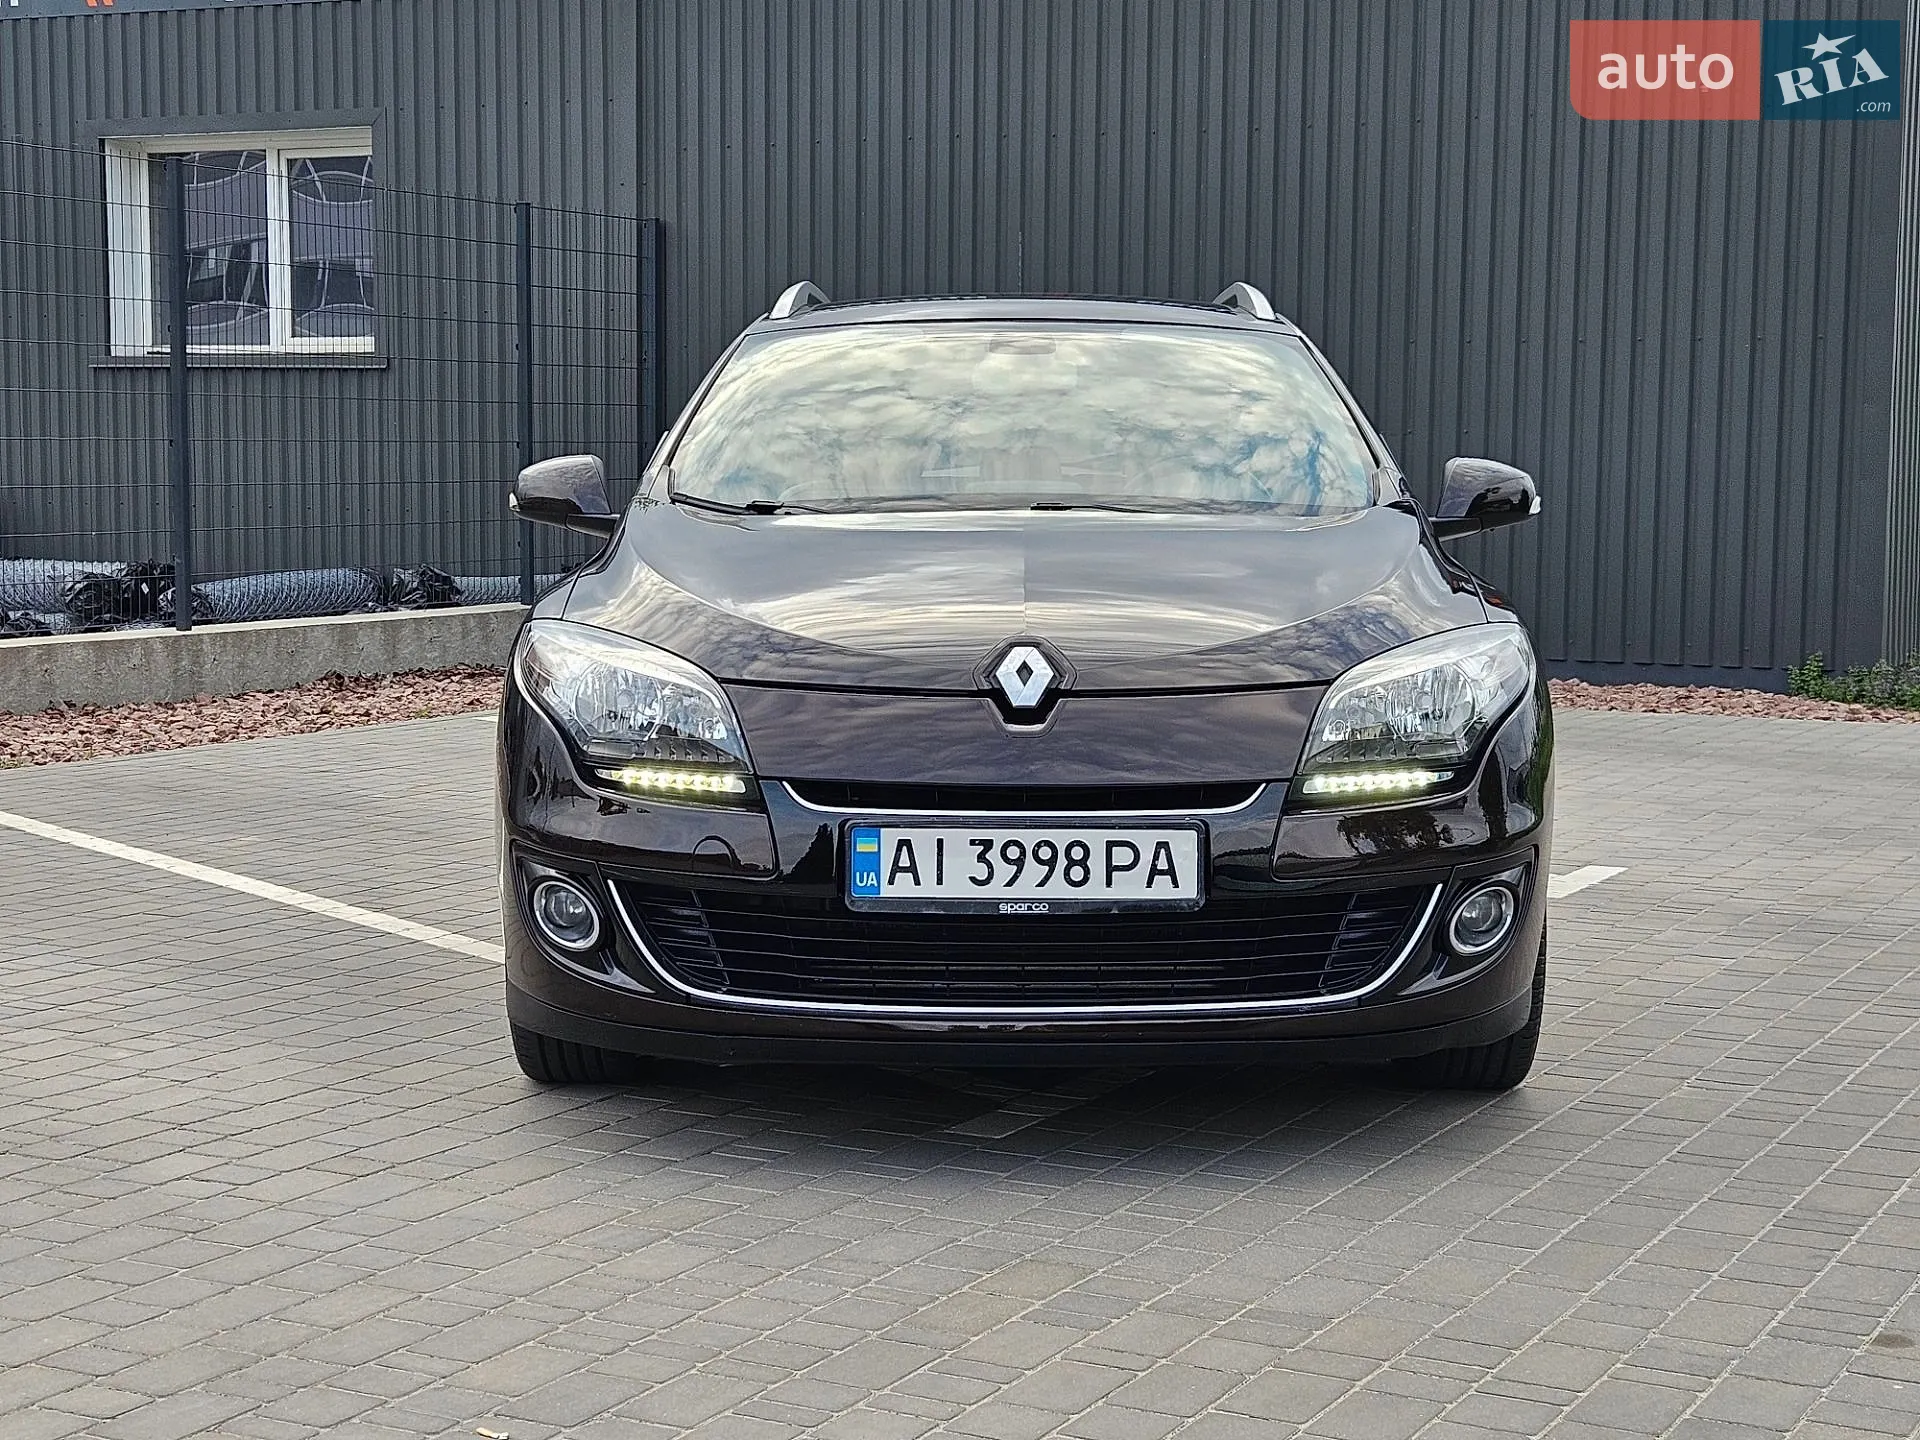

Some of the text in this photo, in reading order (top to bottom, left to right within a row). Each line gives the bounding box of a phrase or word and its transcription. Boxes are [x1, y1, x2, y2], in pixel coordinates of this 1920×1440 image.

[887, 838, 1180, 889] AI 3998 PA
[856, 871, 878, 887] UA
[999, 902, 1049, 915] sparco
